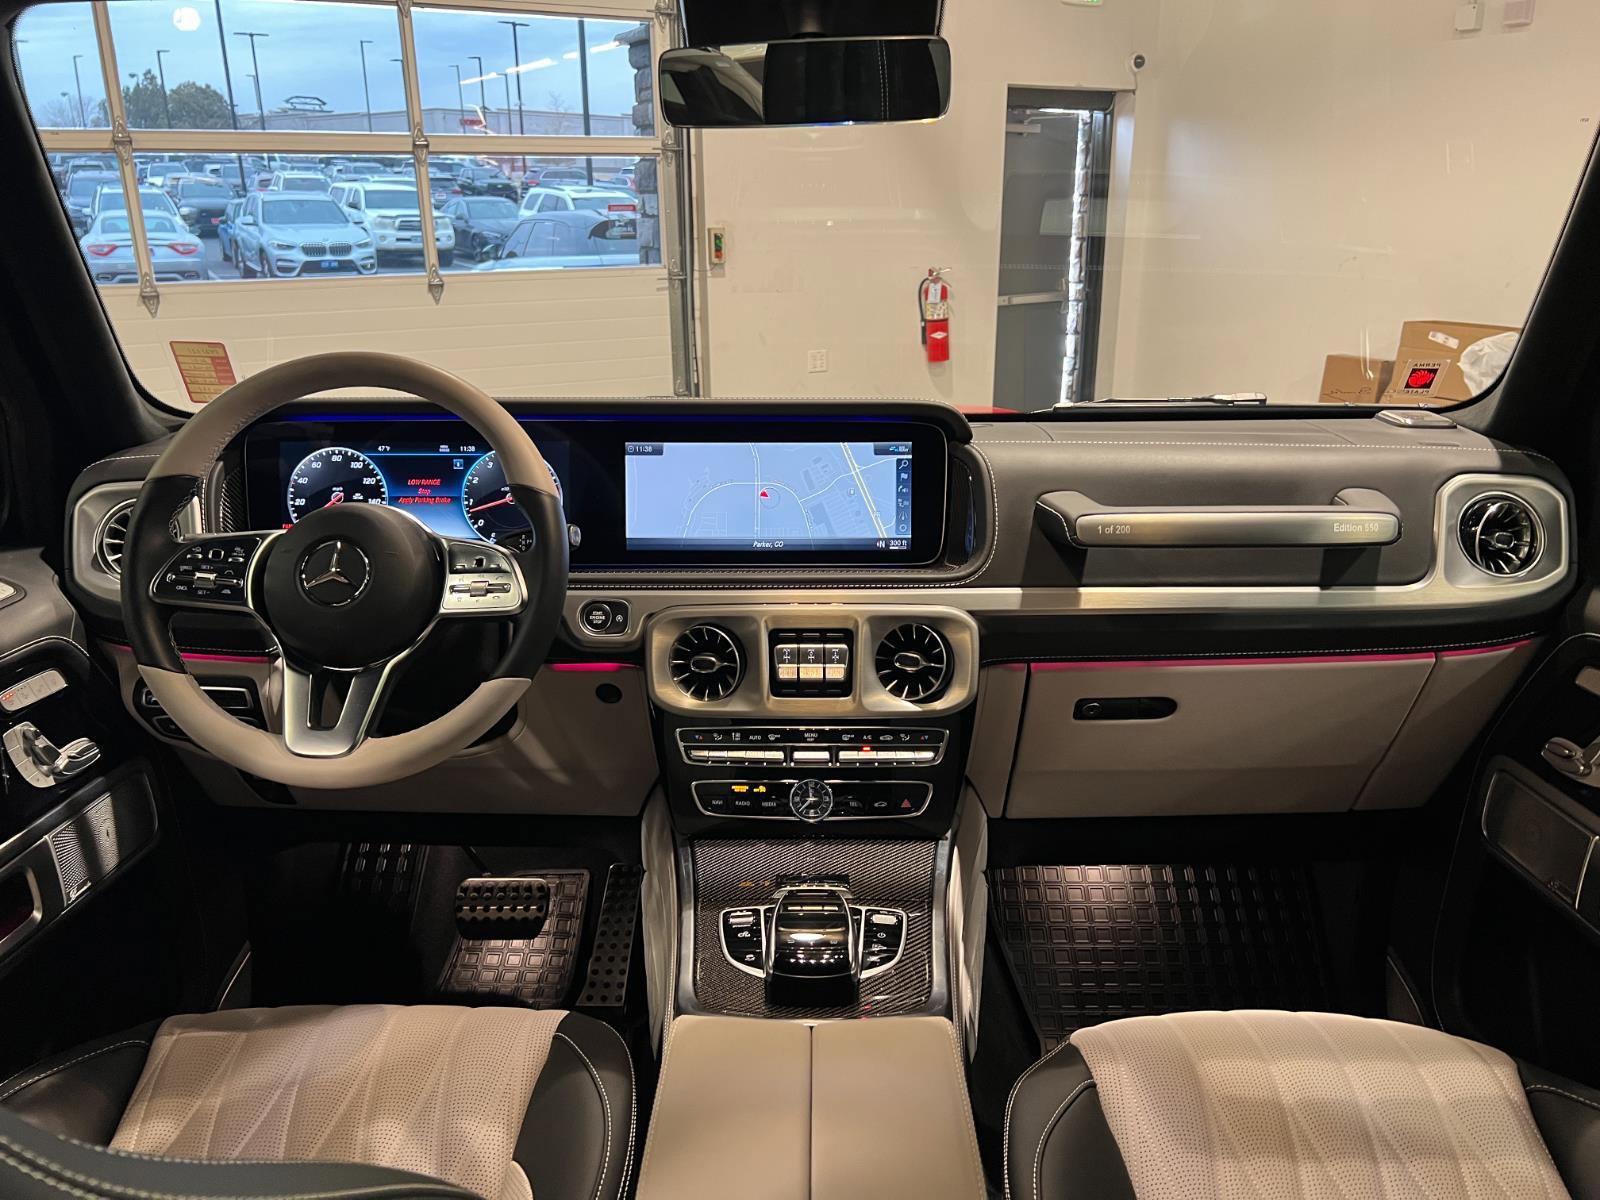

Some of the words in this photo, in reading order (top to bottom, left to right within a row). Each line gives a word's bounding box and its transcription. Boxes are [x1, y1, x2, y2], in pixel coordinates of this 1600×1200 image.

[331, 454, 343, 462] 80
[311, 461, 322, 469] 60
[350, 461, 364, 469] 100
[487, 461, 494, 469] 3
[362, 477, 376, 485] 120
[420, 478, 441, 486] RANGE
[472, 476, 479, 484] 2
[294, 498, 306, 506] 20
[414, 497, 435, 505] Parking
[469, 498, 474, 506] 1
[477, 519, 485, 527] 0
[1333, 522, 1363, 532] Edition
[1097, 525, 1102, 535] 1
[1104, 525, 1114, 535] of
[1115, 525, 1131, 535] 200
